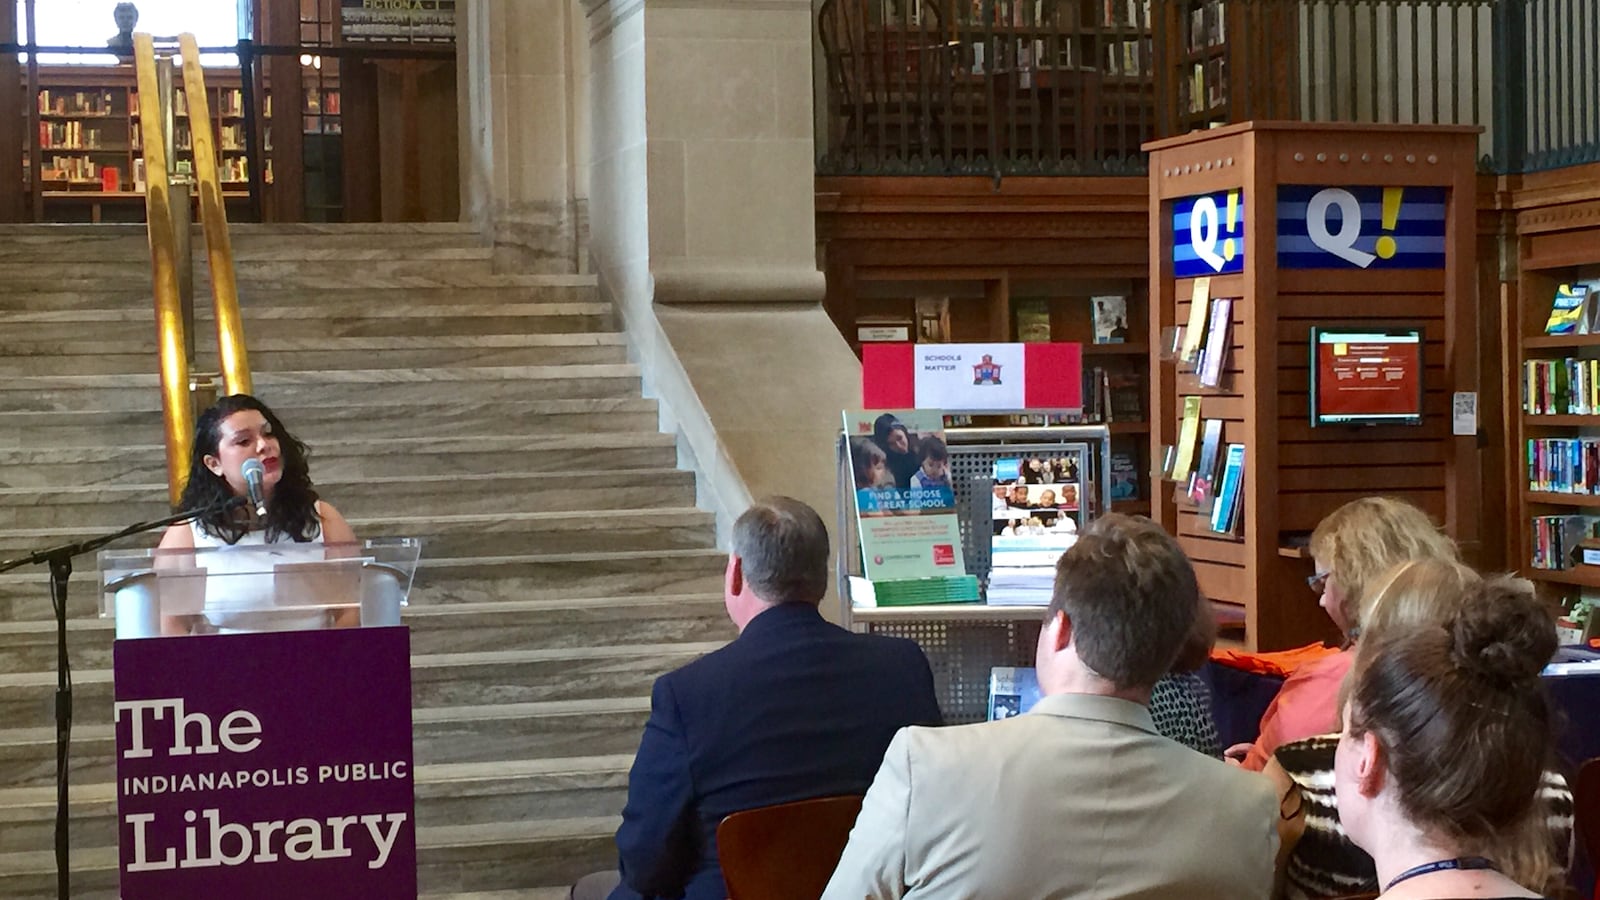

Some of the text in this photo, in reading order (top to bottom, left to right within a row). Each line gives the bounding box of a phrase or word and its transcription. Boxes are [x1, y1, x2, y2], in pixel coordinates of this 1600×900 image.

[363, 0, 412, 9] FICTION
[1190, 190, 1239, 272] Q!
[1306, 187, 1404, 268] Q!
[868, 501, 874, 509] A
[909, 498, 947, 508] SCHOOL
[903, 489, 942, 499] CHOOSE
[114, 698, 262, 760] The
[123, 760, 408, 796] INDIANAPOLIS PUBLIC
[125, 808, 408, 873] Library
